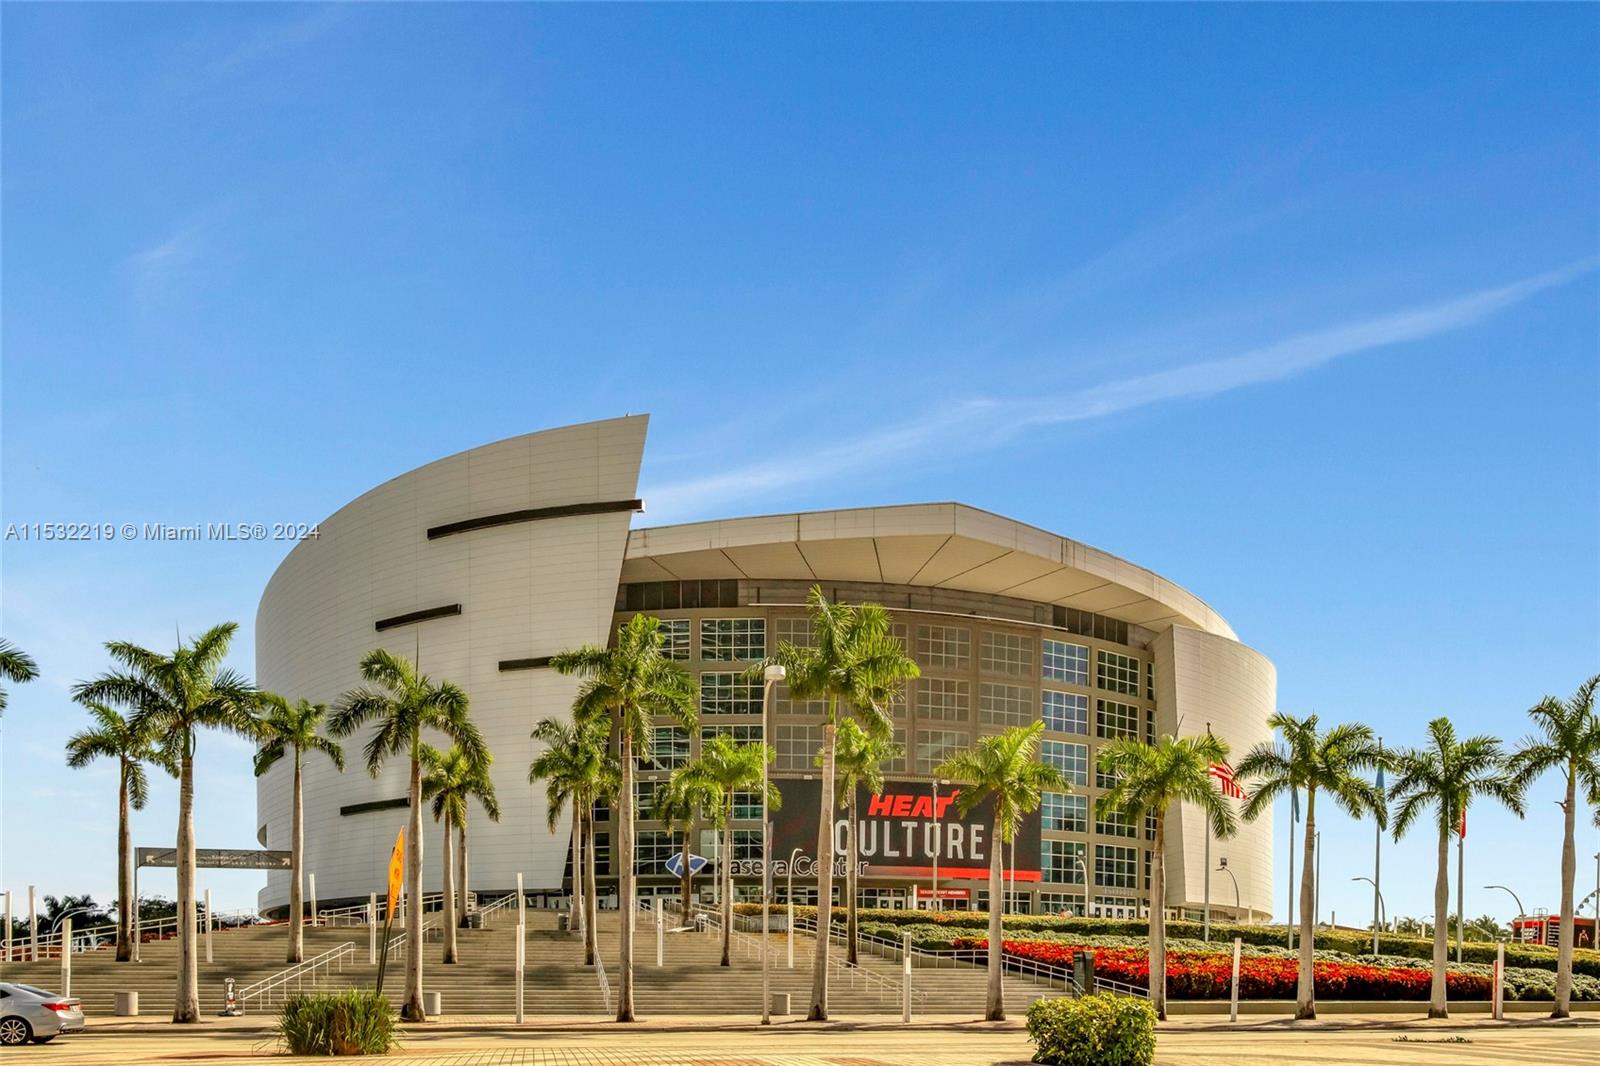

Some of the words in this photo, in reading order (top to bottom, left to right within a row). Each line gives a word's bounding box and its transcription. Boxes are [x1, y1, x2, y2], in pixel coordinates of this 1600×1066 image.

[868, 789, 960, 818] HEAT
[835, 819, 985, 860] CULTURE
[794, 855, 869, 877] Cetr
